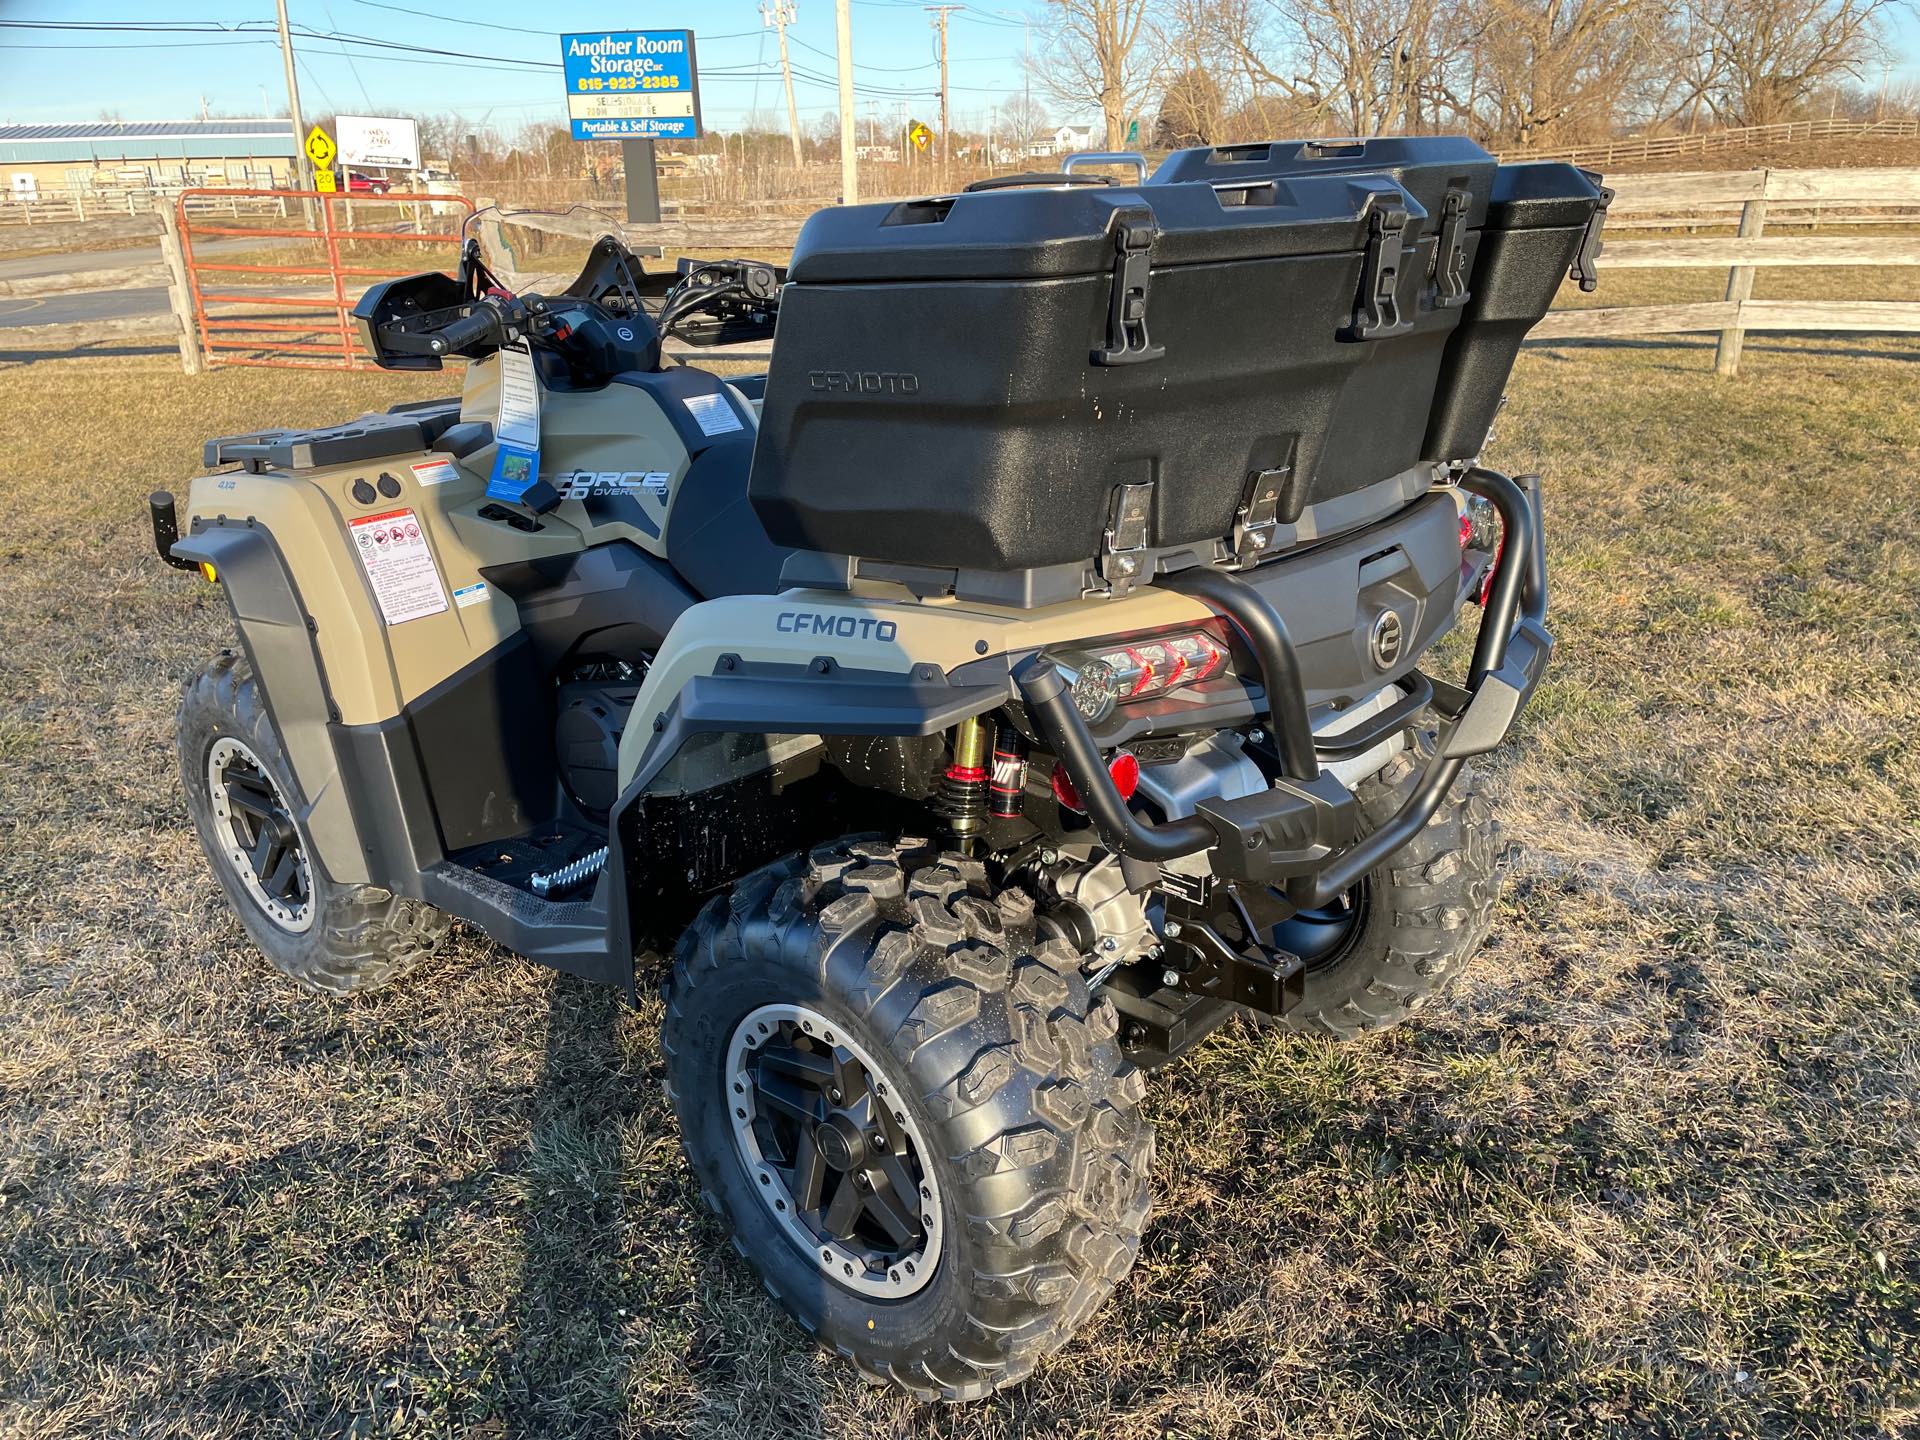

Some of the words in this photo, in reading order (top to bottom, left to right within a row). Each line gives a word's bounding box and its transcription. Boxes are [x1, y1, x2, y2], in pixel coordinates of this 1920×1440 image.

[568, 36, 633, 57] Another
[636, 36, 683, 54] Room
[591, 56, 653, 77] Storage
[579, 75, 680, 90] 815-923-2385
[582, 120, 620, 132] Portable
[620, 121, 629, 132] &
[630, 119, 649, 131] Self
[650, 121, 685, 133] Storage
[318, 173, 332, 184] 20
[808, 370, 919, 394] CFMOTO
[552, 471, 670, 487] FORCE
[593, 487, 668, 496] OVERLAND
[776, 612, 897, 642] CFMOTO
